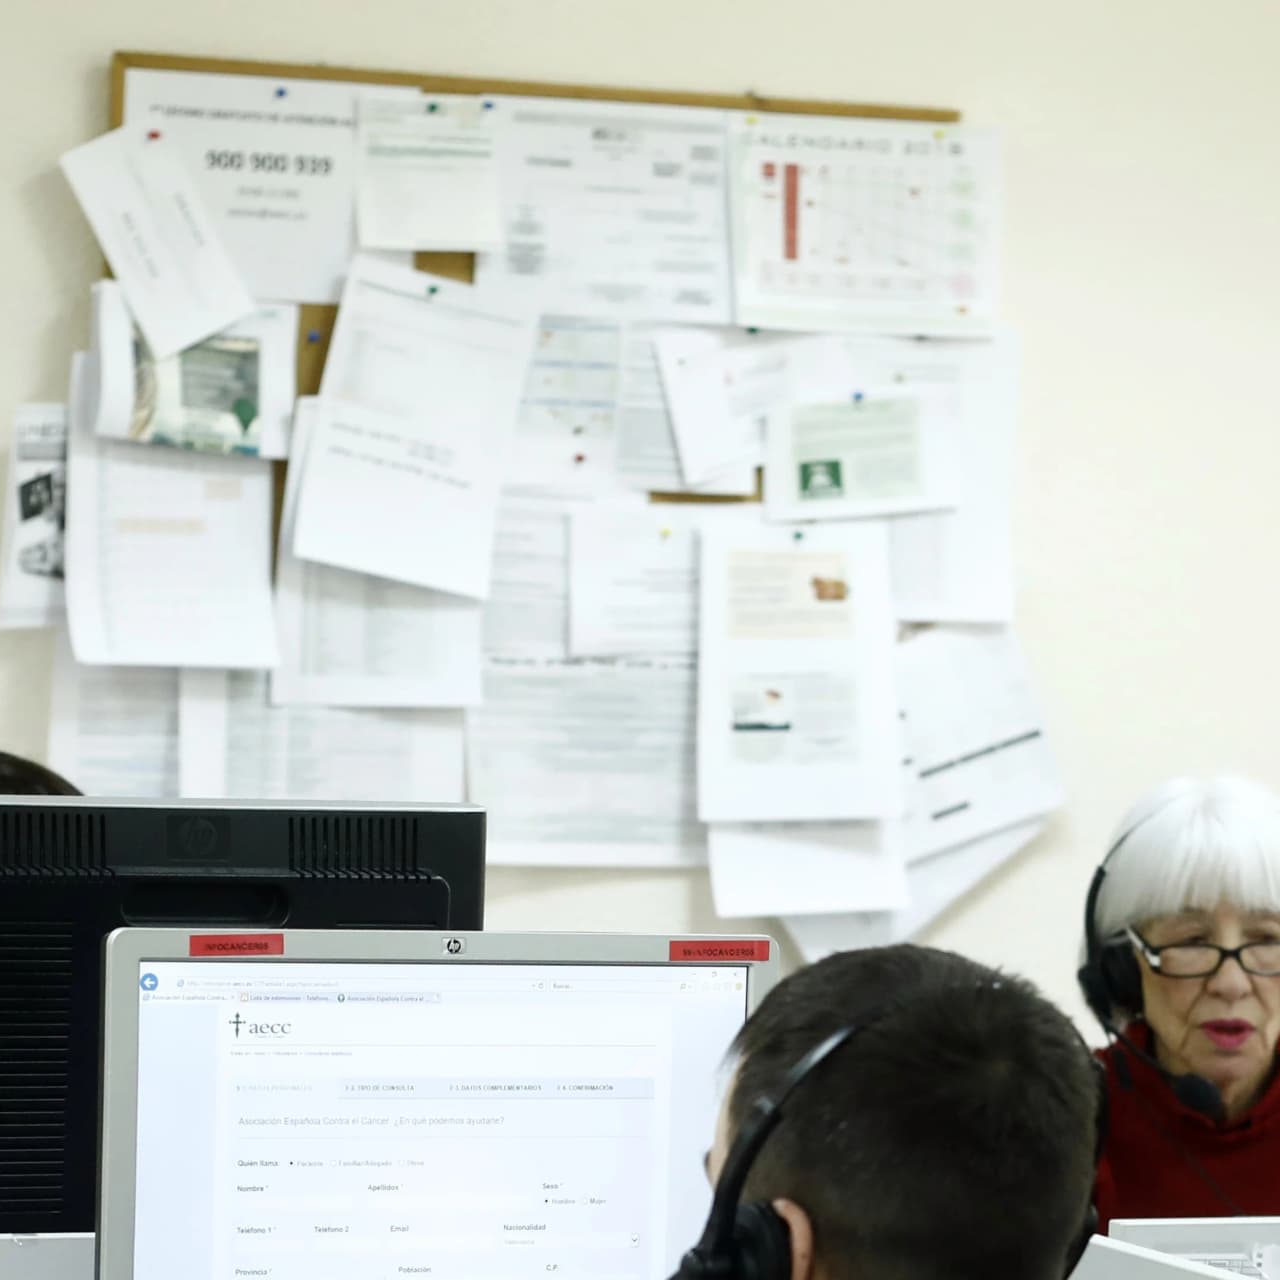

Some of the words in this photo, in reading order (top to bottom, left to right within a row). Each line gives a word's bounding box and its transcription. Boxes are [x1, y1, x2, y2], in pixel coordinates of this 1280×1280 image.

[740, 132, 892, 154] CALENDARIO
[205, 151, 244, 170] 900
[250, 152, 289, 172] 900
[248, 1023, 291, 1034] aecc
[238, 1116, 282, 1126] Asociación
[284, 1116, 321, 1127] Española
[323, 1116, 350, 1126] Contra
[428, 1116, 465, 1127] podemos
[368, 1184, 399, 1193] Apellidos
[390, 1224, 409, 1233] Email
[503, 1223, 547, 1232] Nacionalidad
[234, 1267, 268, 1276] Provincia
[398, 1265, 432, 1274] Población
